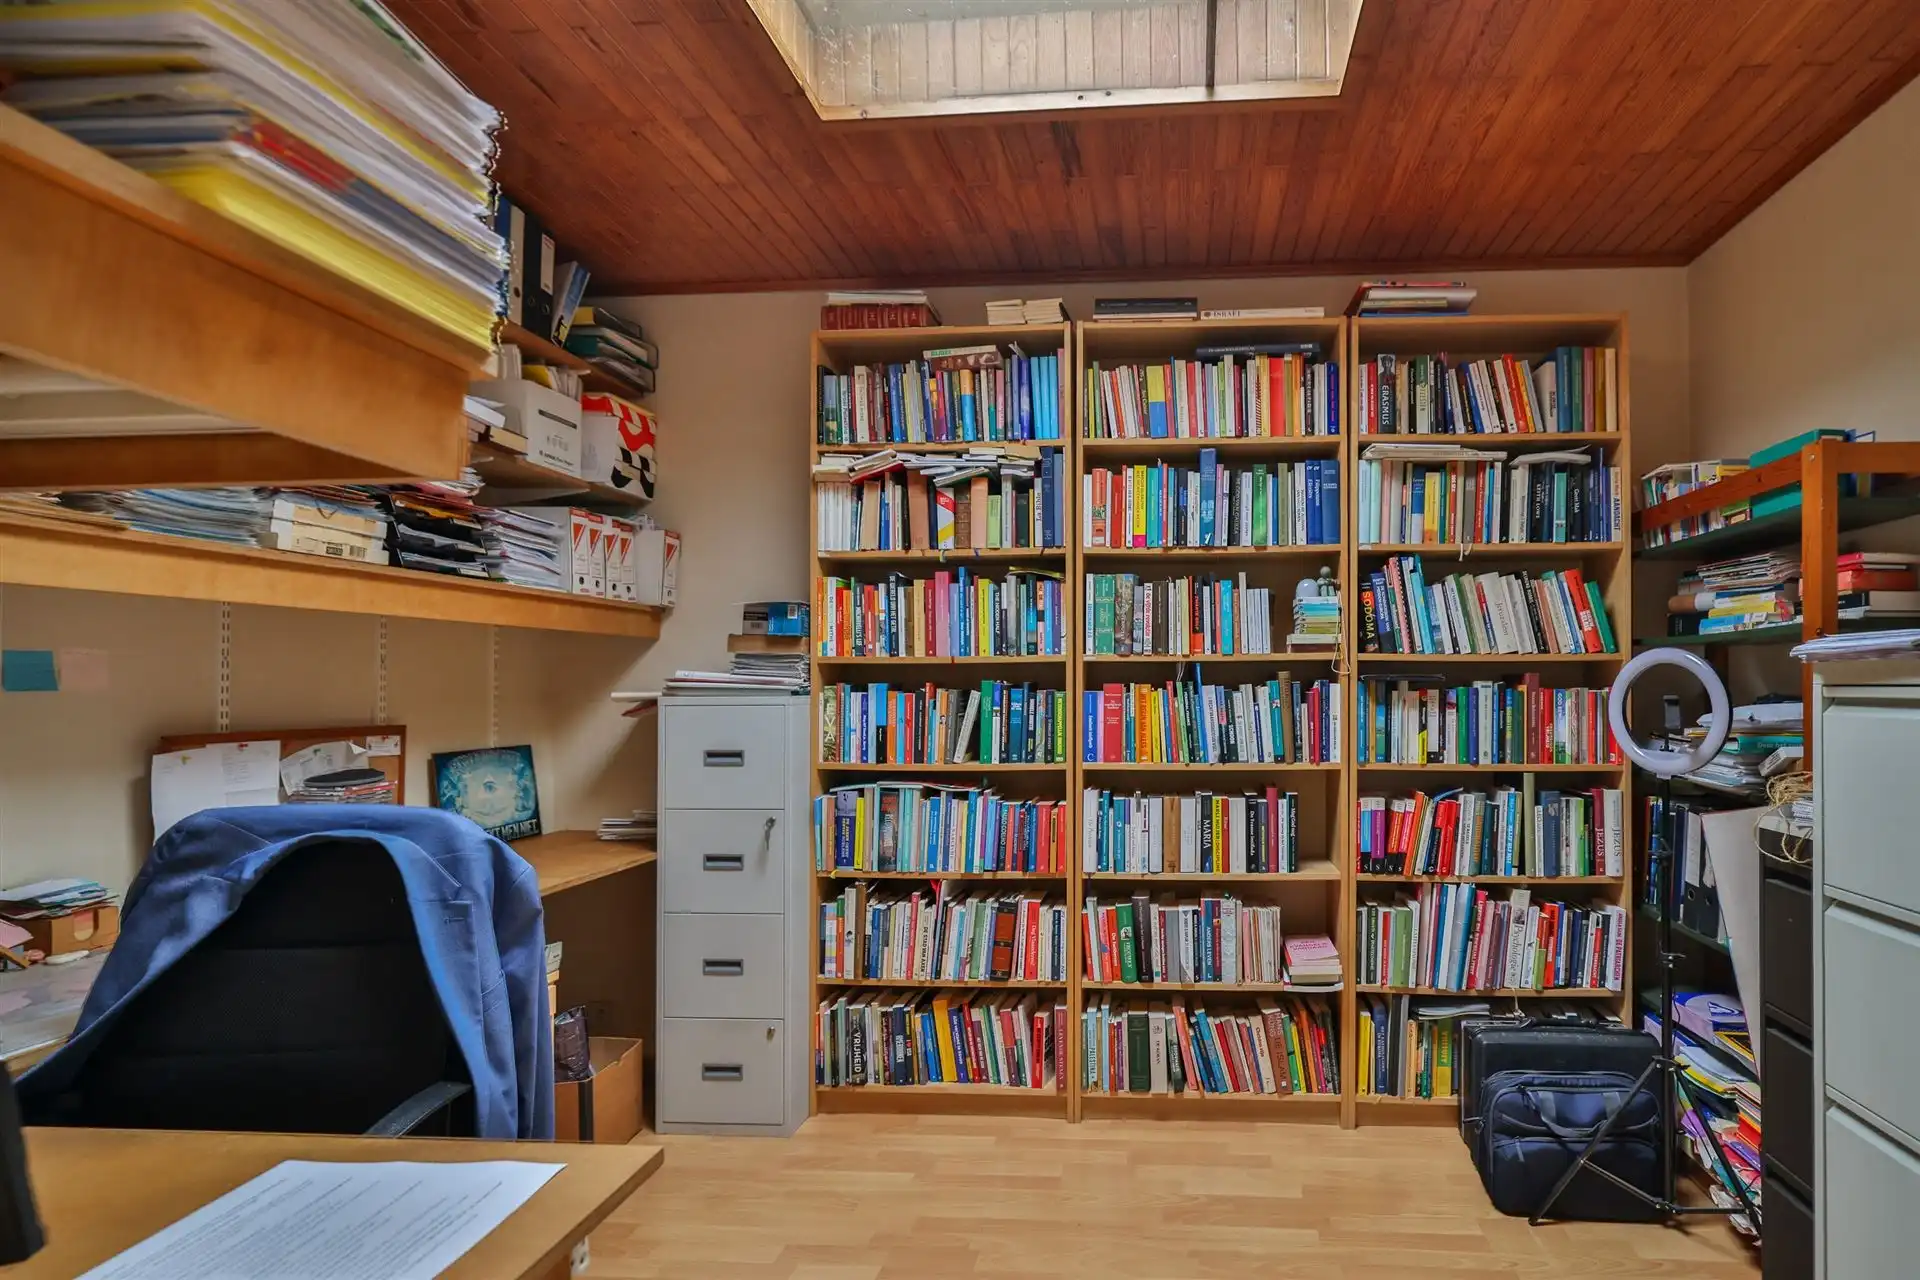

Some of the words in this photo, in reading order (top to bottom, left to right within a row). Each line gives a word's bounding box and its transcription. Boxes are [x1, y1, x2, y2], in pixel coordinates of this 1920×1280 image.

[1381, 384, 1391, 425] ERASMUS
[1363, 591, 1375, 639] SODOMA
[520, 818, 539, 835] NIET
[1203, 819, 1212, 849] MARIA
[1595, 828, 1605, 857] JEZUS
[1611, 828, 1622, 857] JEZUS
[923, 926, 929, 934] DE
[1510, 924, 1524, 972] Psychologie
[854, 1032, 862, 1073] VRIJHEID
[1089, 1047, 1097, 1074] PALESTINA
